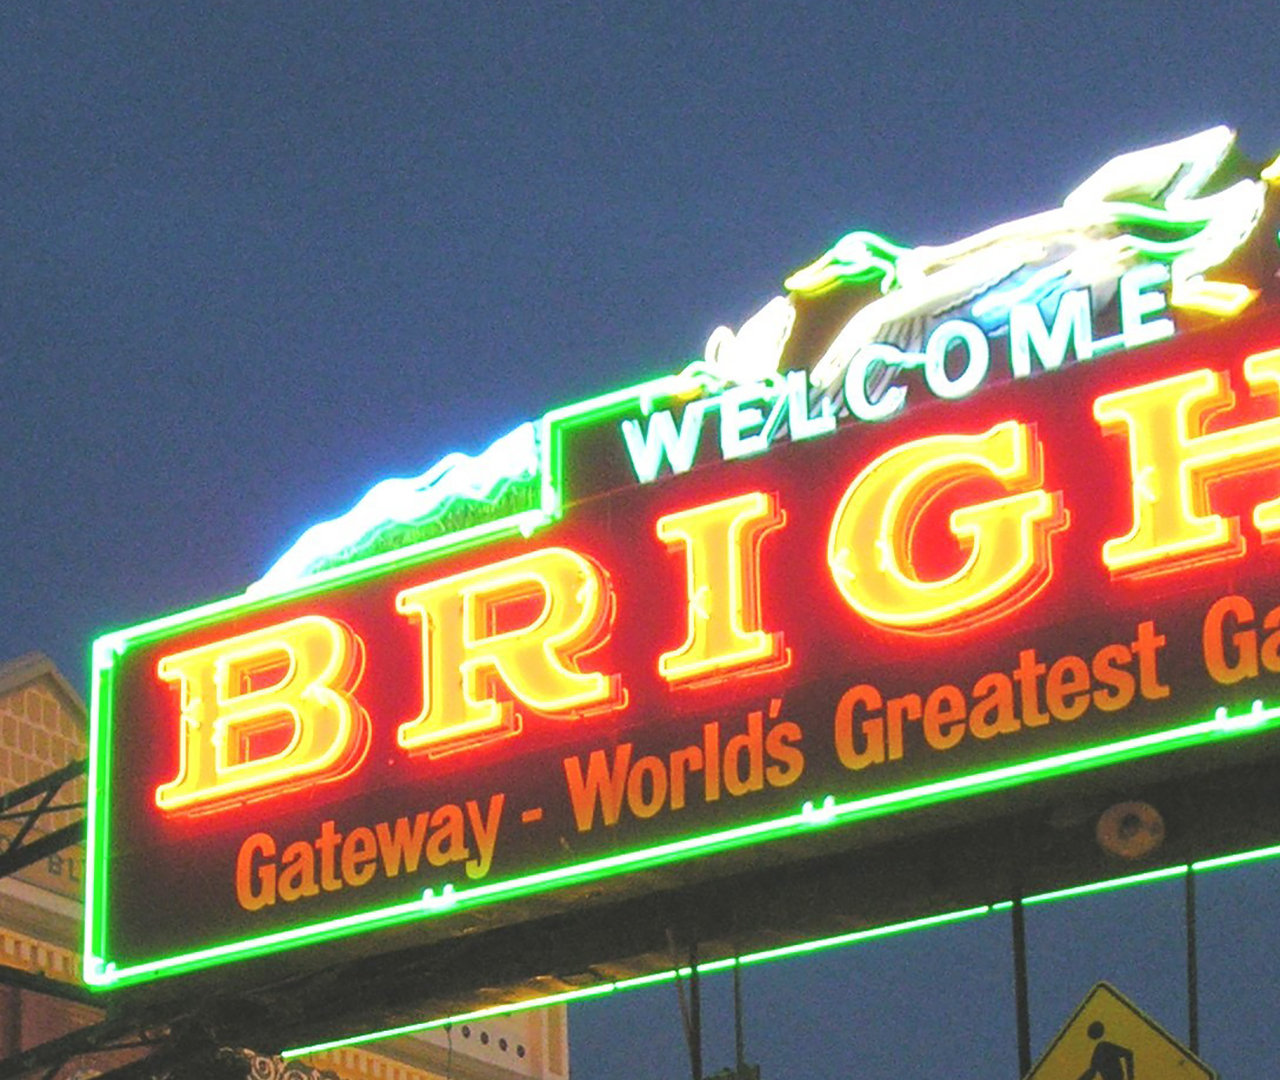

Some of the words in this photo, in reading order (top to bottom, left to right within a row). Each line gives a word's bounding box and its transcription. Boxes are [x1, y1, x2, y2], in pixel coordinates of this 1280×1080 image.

[622, 264, 1175, 484] WELCOME
[235, 793, 505, 912] Gateway
[565, 699, 803, 830] World's
[833, 620, 1170, 771] Greatest
